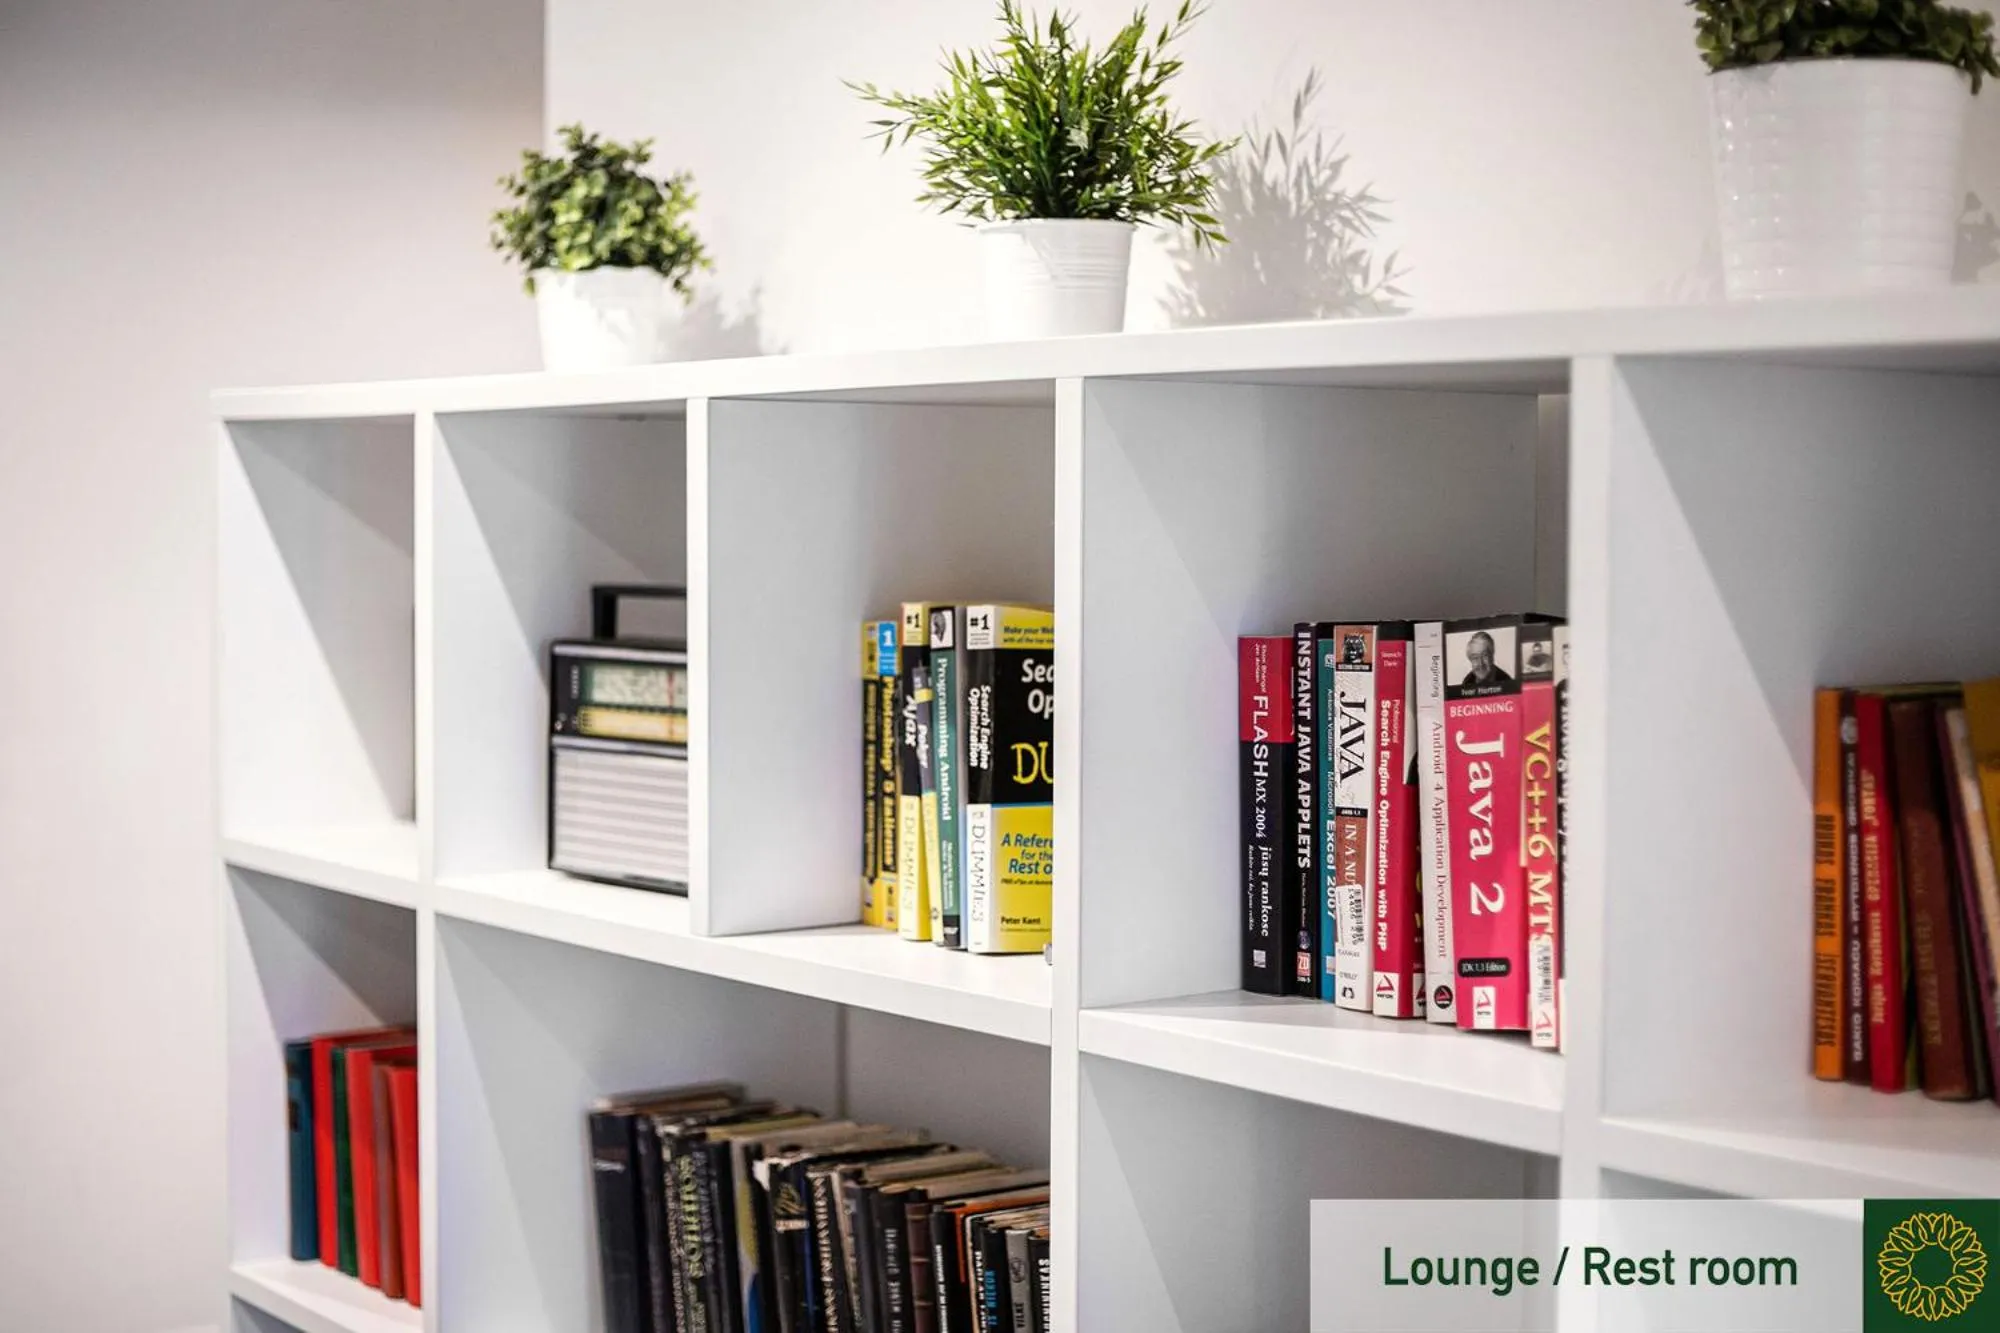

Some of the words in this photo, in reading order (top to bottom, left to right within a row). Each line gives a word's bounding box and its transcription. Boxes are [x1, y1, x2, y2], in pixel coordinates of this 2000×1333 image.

[882, 630, 893, 647] 1
[906, 613, 921, 628] #1
[970, 614, 990, 630] #1
[1297, 631, 1312, 720] INSTANT
[1430, 655, 1440, 699] Beginning
[902, 694, 917, 747] Ajax
[935, 658, 950, 758] Programming
[979, 684, 992, 725] Search
[1380, 700, 1392, 747] Search
[1449, 700, 1514, 718] BEGINNING
[916, 724, 929, 769] Poker
[968, 687, 981, 767] Optimization
[979, 726, 992, 769] Engine
[1253, 695, 1269, 777] FLASH
[1297, 724, 1312, 774] JAVA
[1340, 691, 1366, 784] JAVA
[1432, 722, 1443, 775] Android
[938, 760, 951, 821] Android
[1255, 778, 1267, 804] MX
[1327, 772, 1336, 816] Microsoft
[1378, 751, 1391, 796] Engine
[1434, 783, 1443, 791] 4
[1455, 729, 1505, 861] Java
[1001, 833, 1012, 847] A
[1255, 807, 1267, 839] 2004
[1297, 779, 1312, 868] APPLETS
[1326, 819, 1337, 869] Excel
[1345, 824, 1357, 840] IN
[1378, 799, 1391, 885] Optimization
[1432, 798, 1446, 870] Application
[971, 825, 987, 922] DUMMIES
[1008, 858, 1041, 875] Rest
[1020, 849, 1037, 861] for
[1345, 847, 1357, 857] A
[1326, 875, 1337, 920] 2007
[1378, 889, 1389, 919] with
[1434, 875, 1448, 958] Development
[1470, 881, 1505, 916] 2
[1001, 915, 1020, 925] Peter
[1022, 915, 1041, 925] Kent
[1377, 921, 1389, 951] PHP
